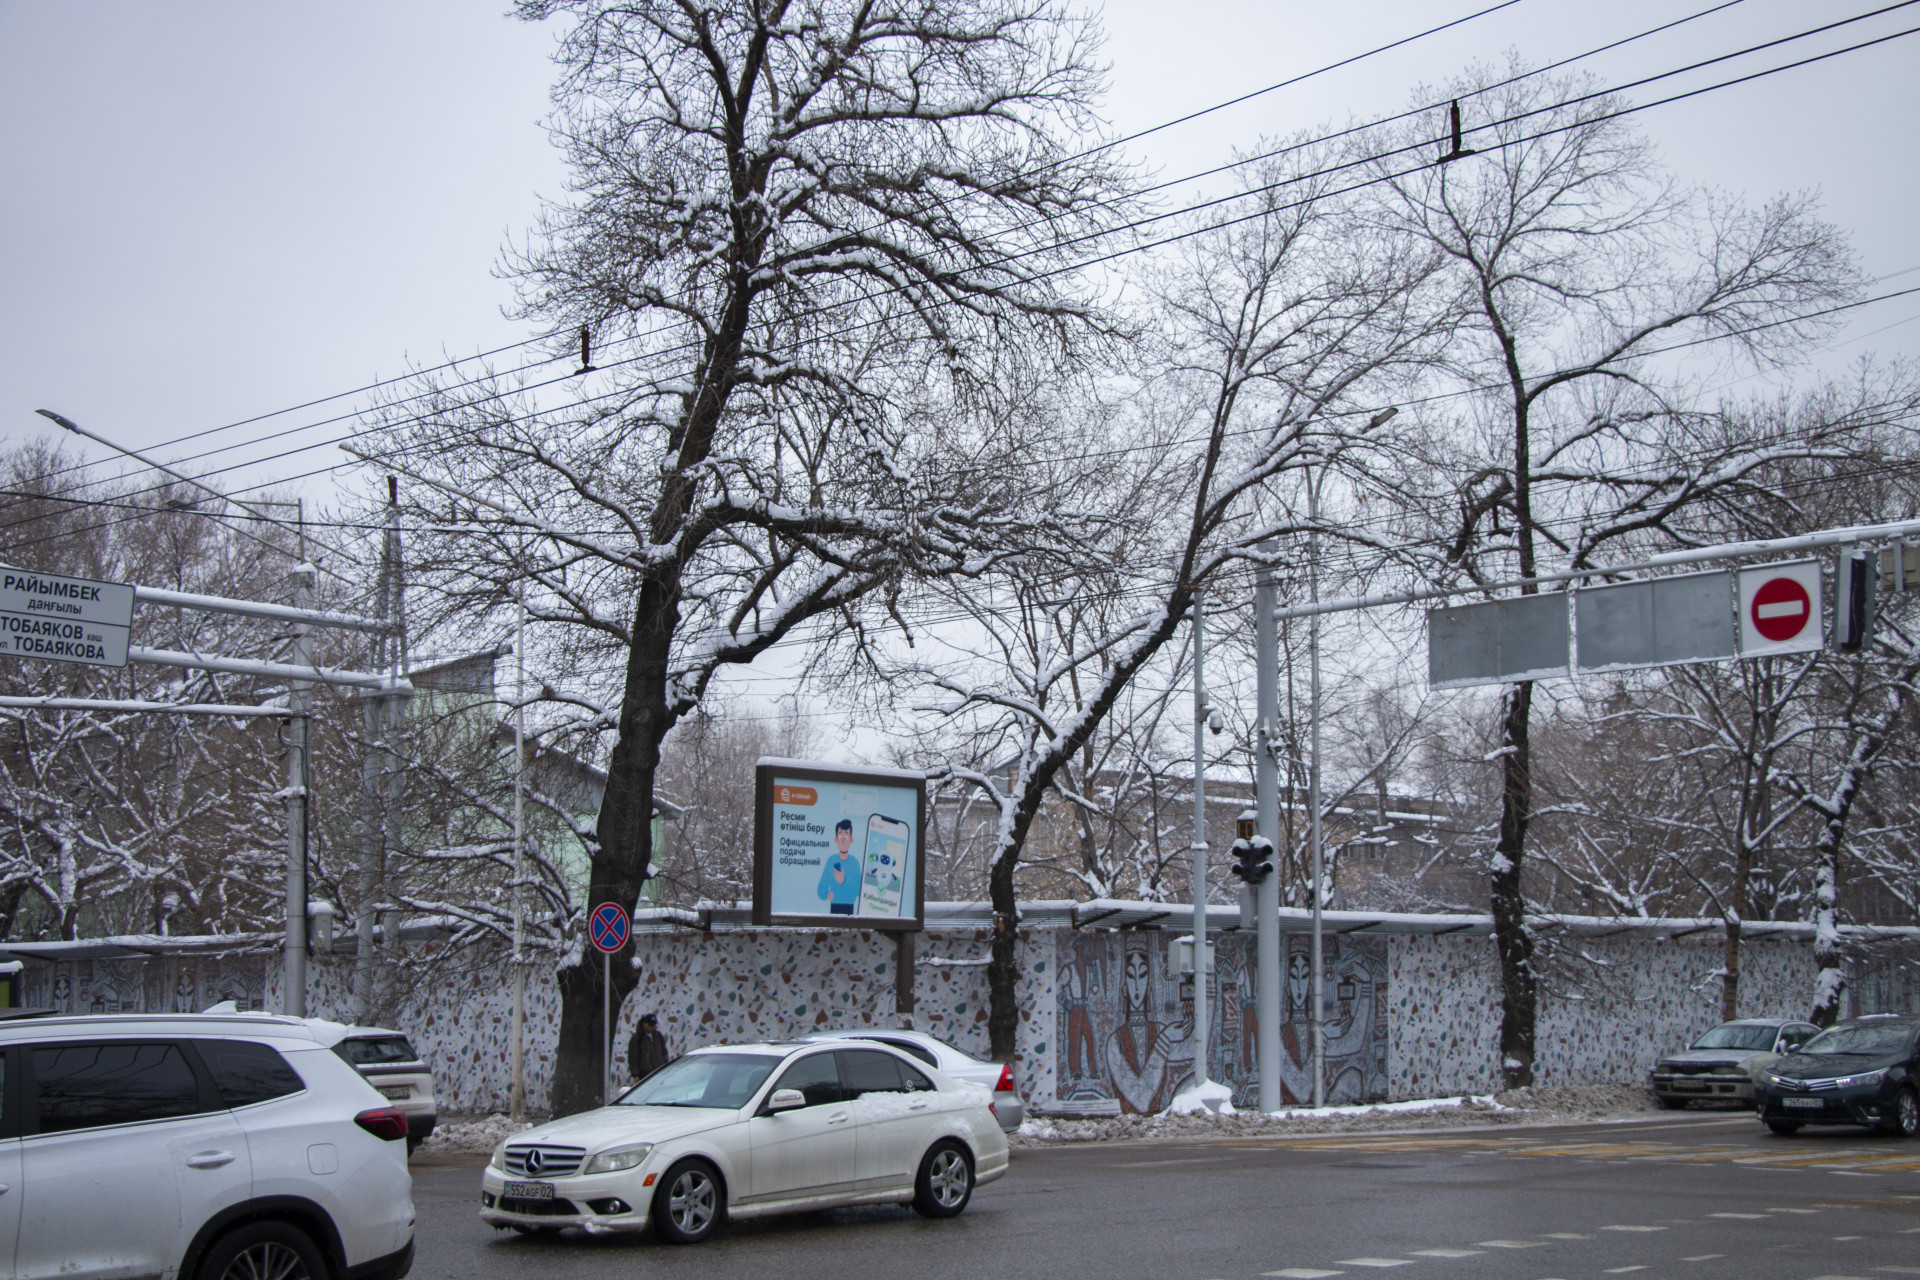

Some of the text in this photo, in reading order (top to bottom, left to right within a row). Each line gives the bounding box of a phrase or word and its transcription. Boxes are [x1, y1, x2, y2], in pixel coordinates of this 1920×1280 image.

[4, 575, 101, 602] РАЙЫМБЕК
[27, 599, 82, 614] даңғылы
[1, 616, 83, 640] ТОБАЯҚОВ
[14, 636, 105, 660] ТОБАЯКОВА
[780, 811, 806, 821] Ресми
[780, 821, 825, 835] өтініш беру
[780, 837, 830, 848] Официальная
[780, 848, 806, 857] подача
[780, 856, 821, 867] обращений
[541, 1185, 552, 1198] 02
